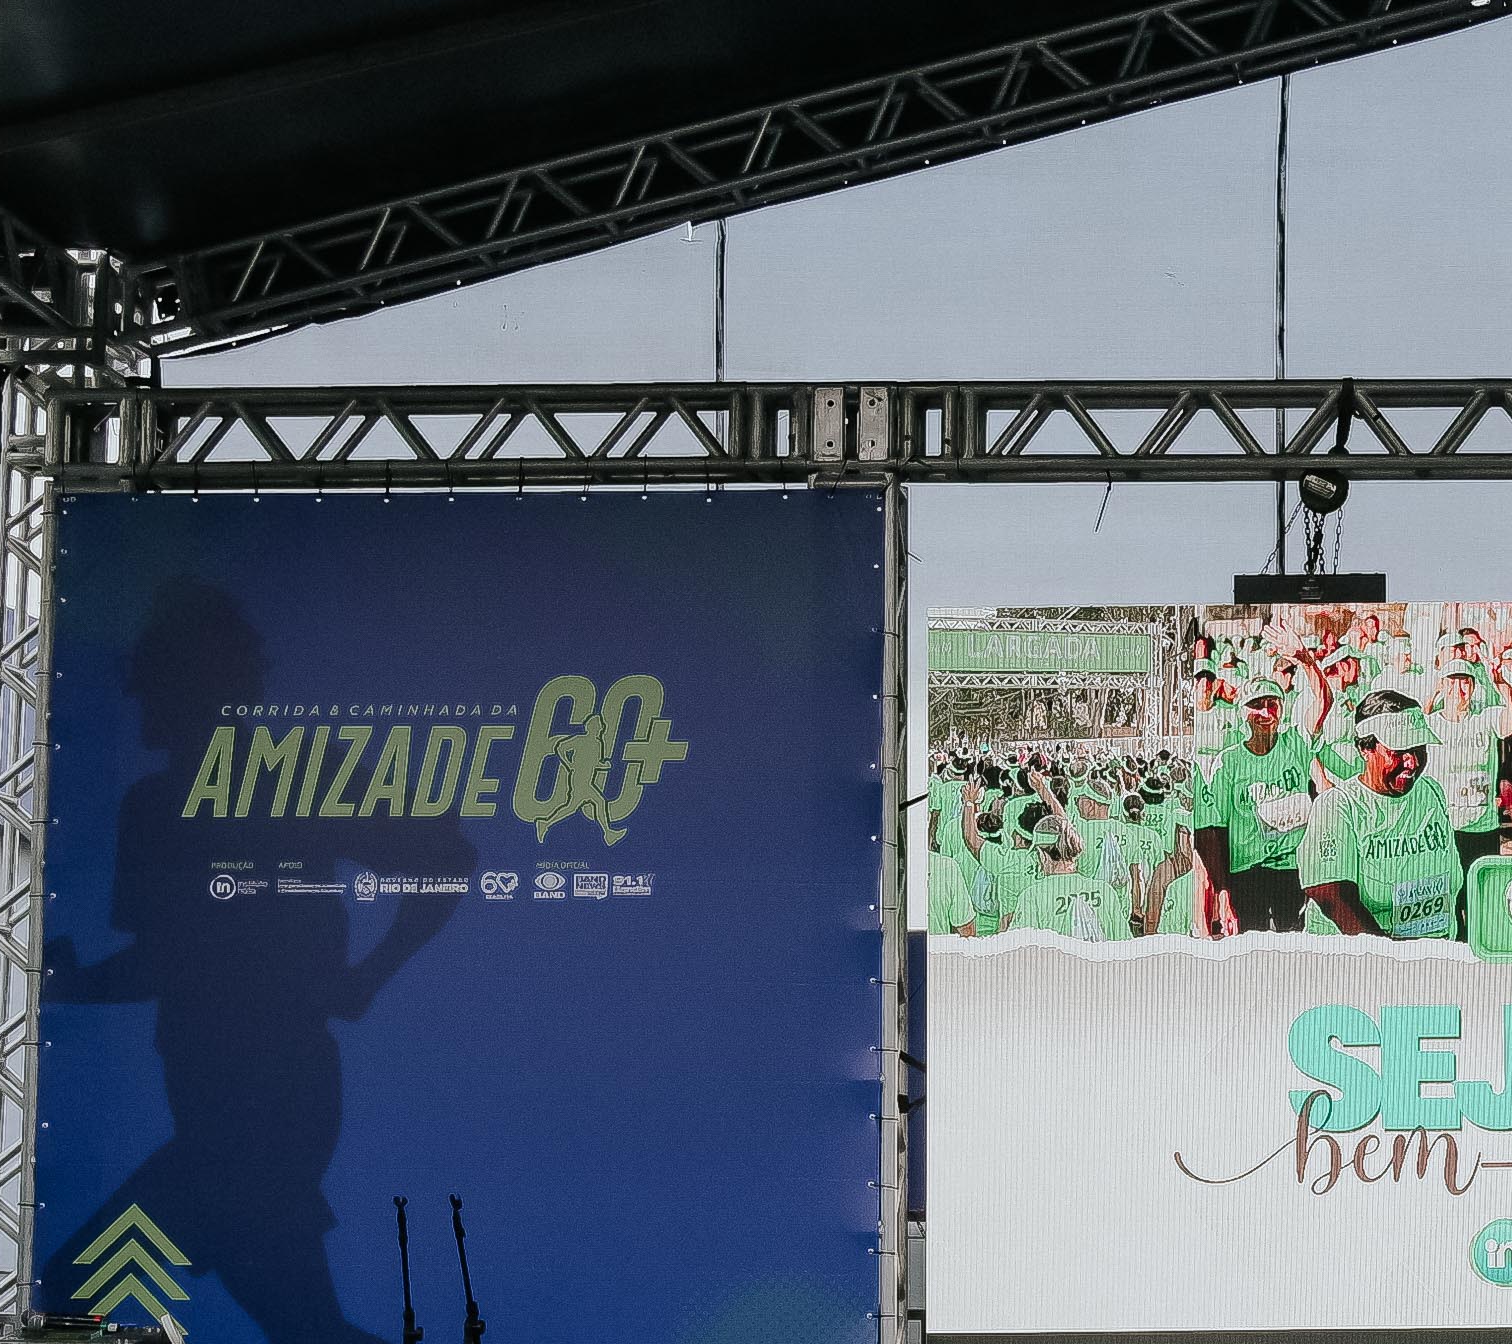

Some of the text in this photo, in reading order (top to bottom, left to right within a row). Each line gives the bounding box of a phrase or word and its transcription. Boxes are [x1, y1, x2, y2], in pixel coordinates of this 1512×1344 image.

[968, 623, 1101, 659] LARGADA
[221, 705, 322, 717] CORRIDA
[349, 704, 482, 717] CAMINHADA
[491, 704, 519, 716] DA
[181, 725, 515, 818] AMIZADE
[1400, 897, 1444, 922] 0269
